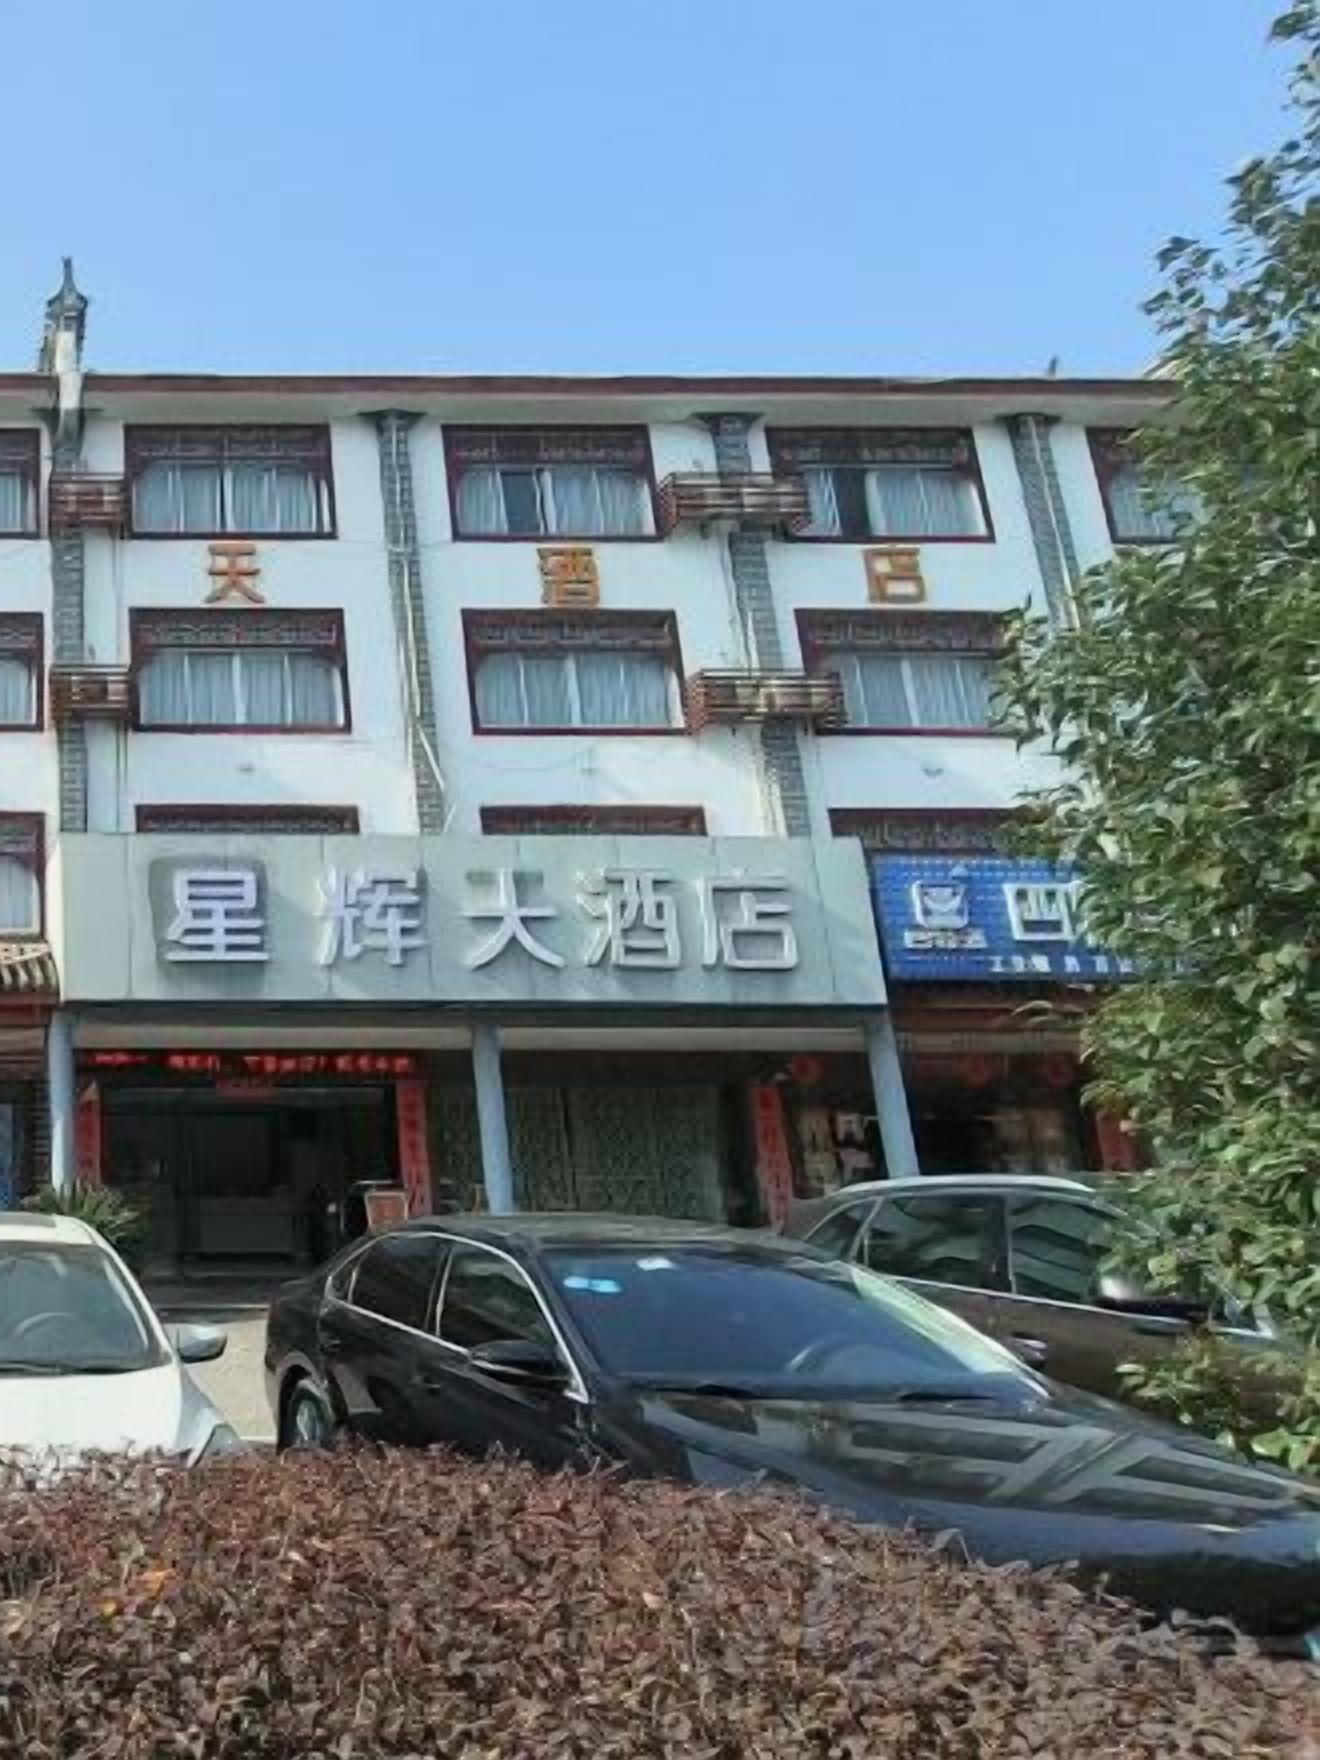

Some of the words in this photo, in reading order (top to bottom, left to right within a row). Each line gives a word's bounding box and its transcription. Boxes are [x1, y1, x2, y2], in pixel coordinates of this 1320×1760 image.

[165, 865, 800, 971] 星辉大酒店
